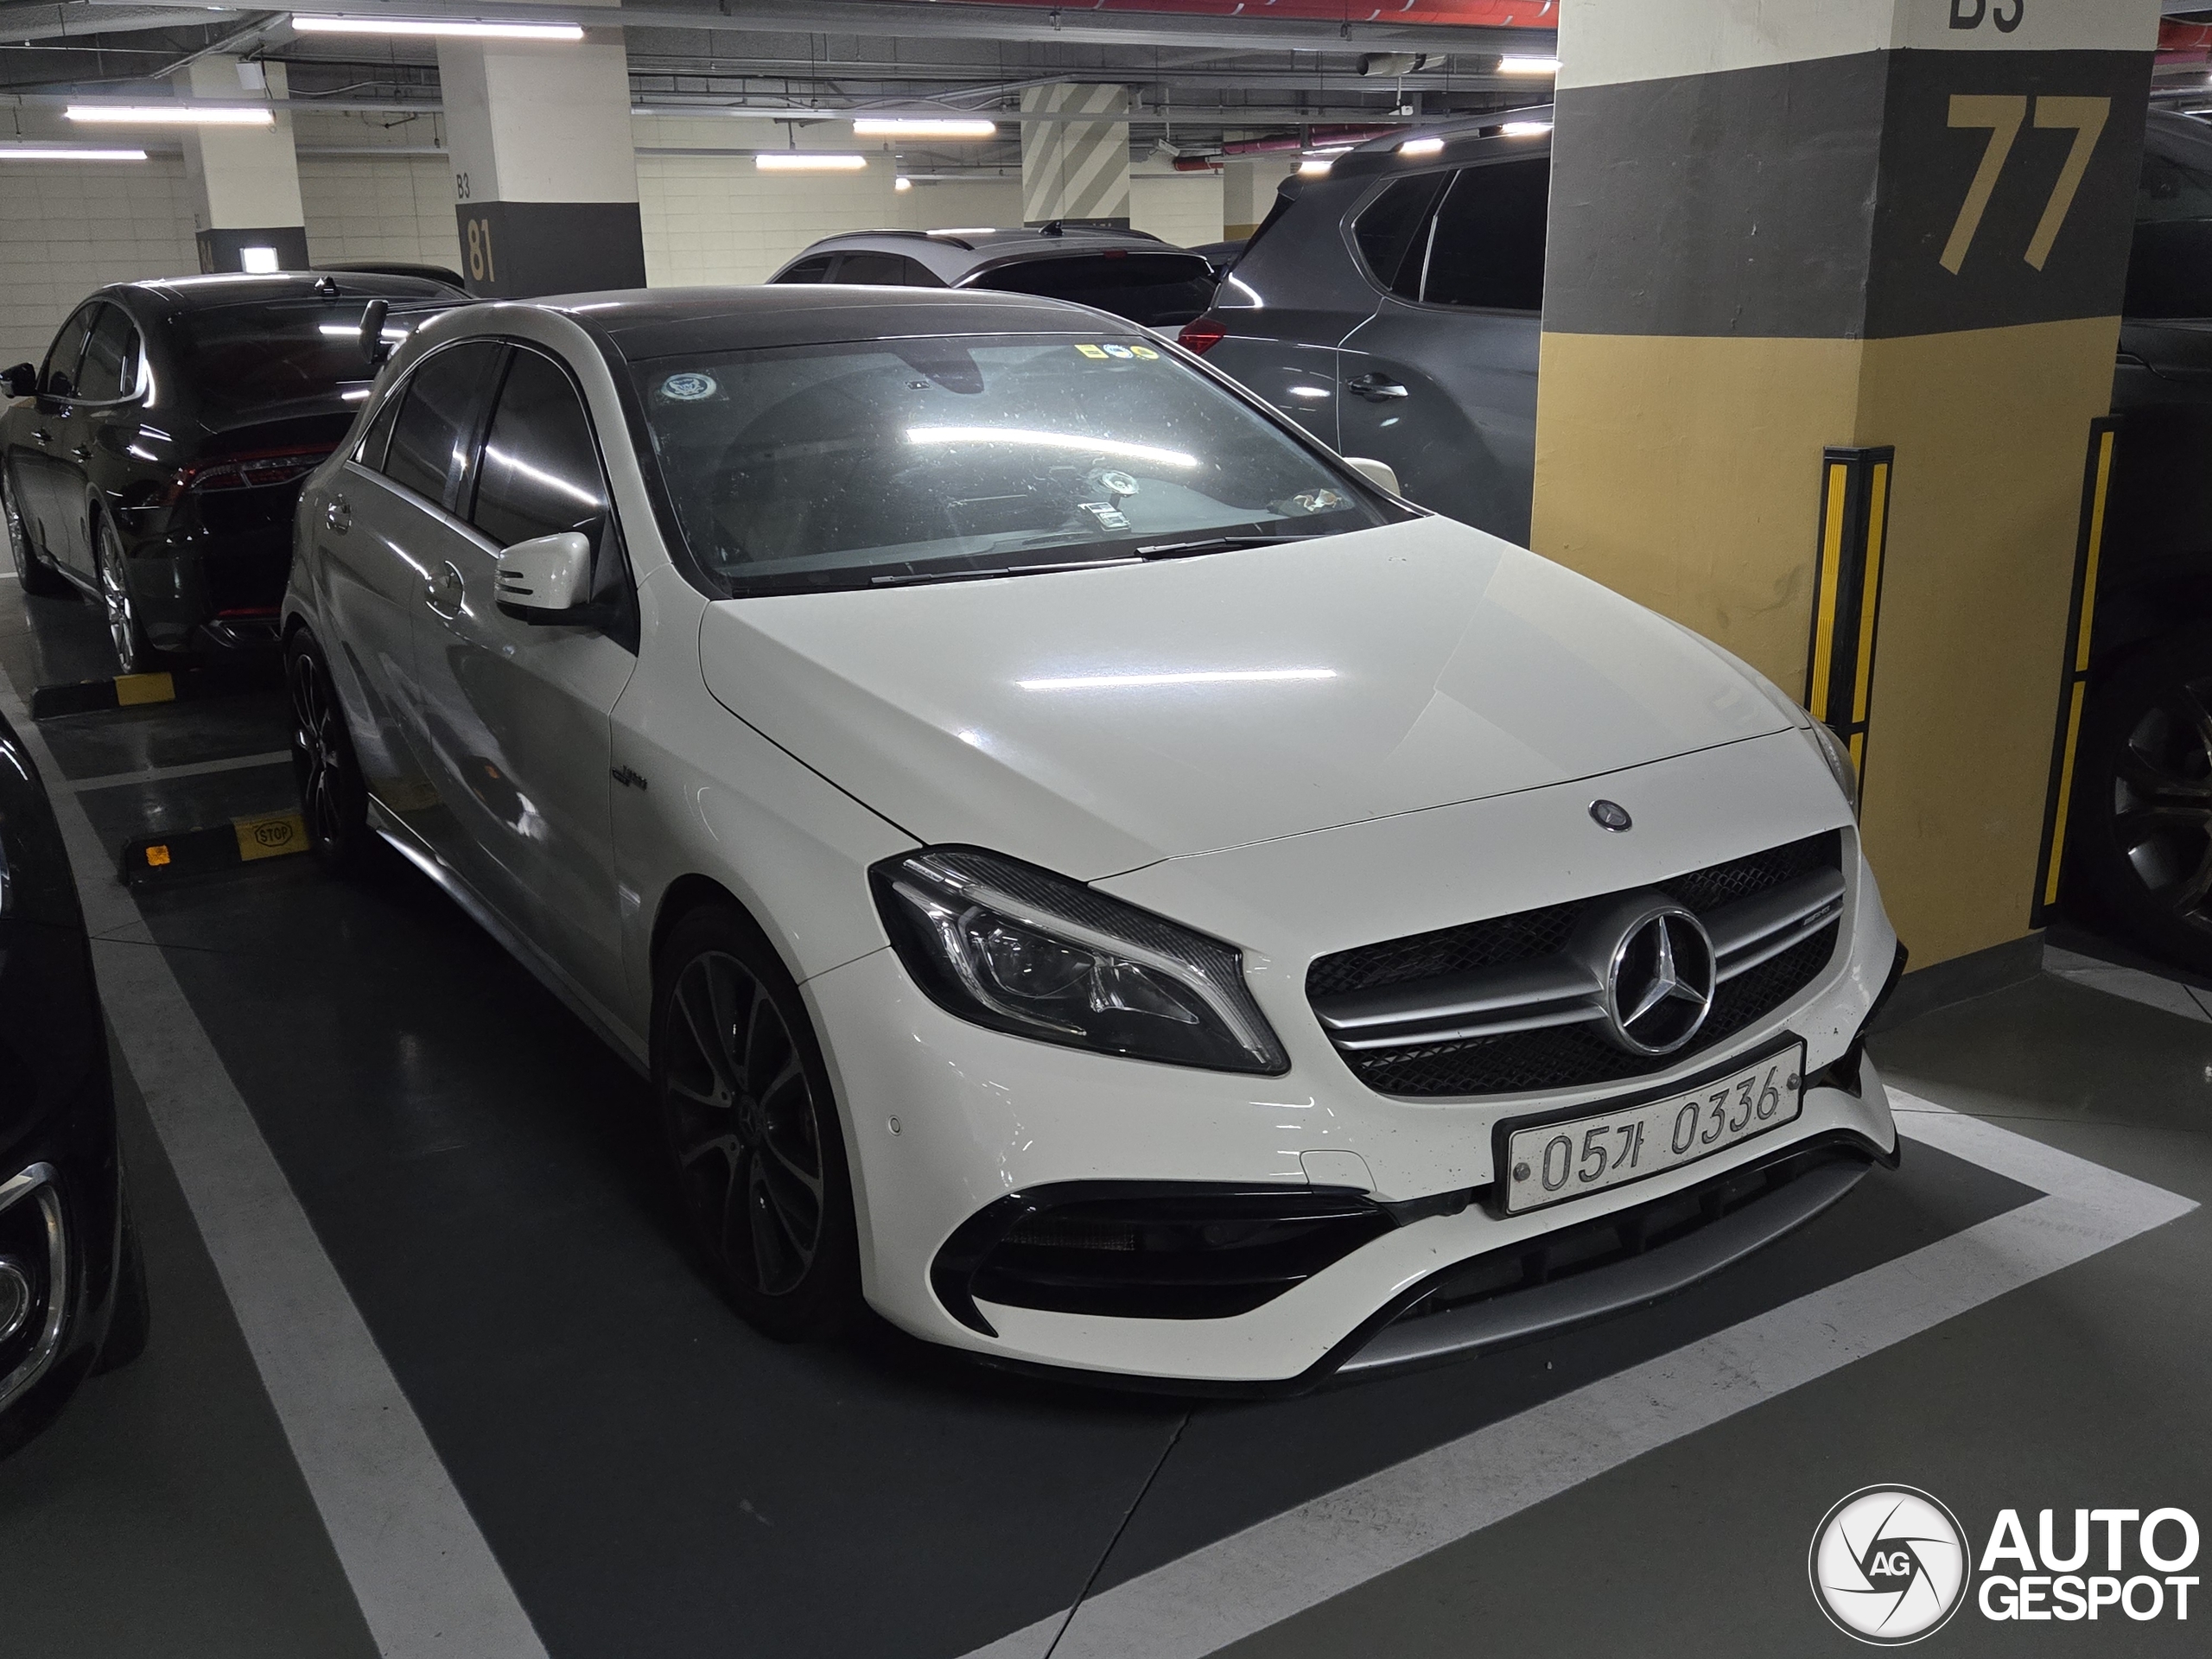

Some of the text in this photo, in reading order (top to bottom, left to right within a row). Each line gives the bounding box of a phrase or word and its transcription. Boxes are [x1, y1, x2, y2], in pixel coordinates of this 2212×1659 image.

[456, 173, 470, 199] B3
[1939, 94, 2111, 275] 77
[467, 219, 495, 282] 81
[260, 826, 288, 842] STOP
[1542, 1066, 1779, 1192] 05가 0336
